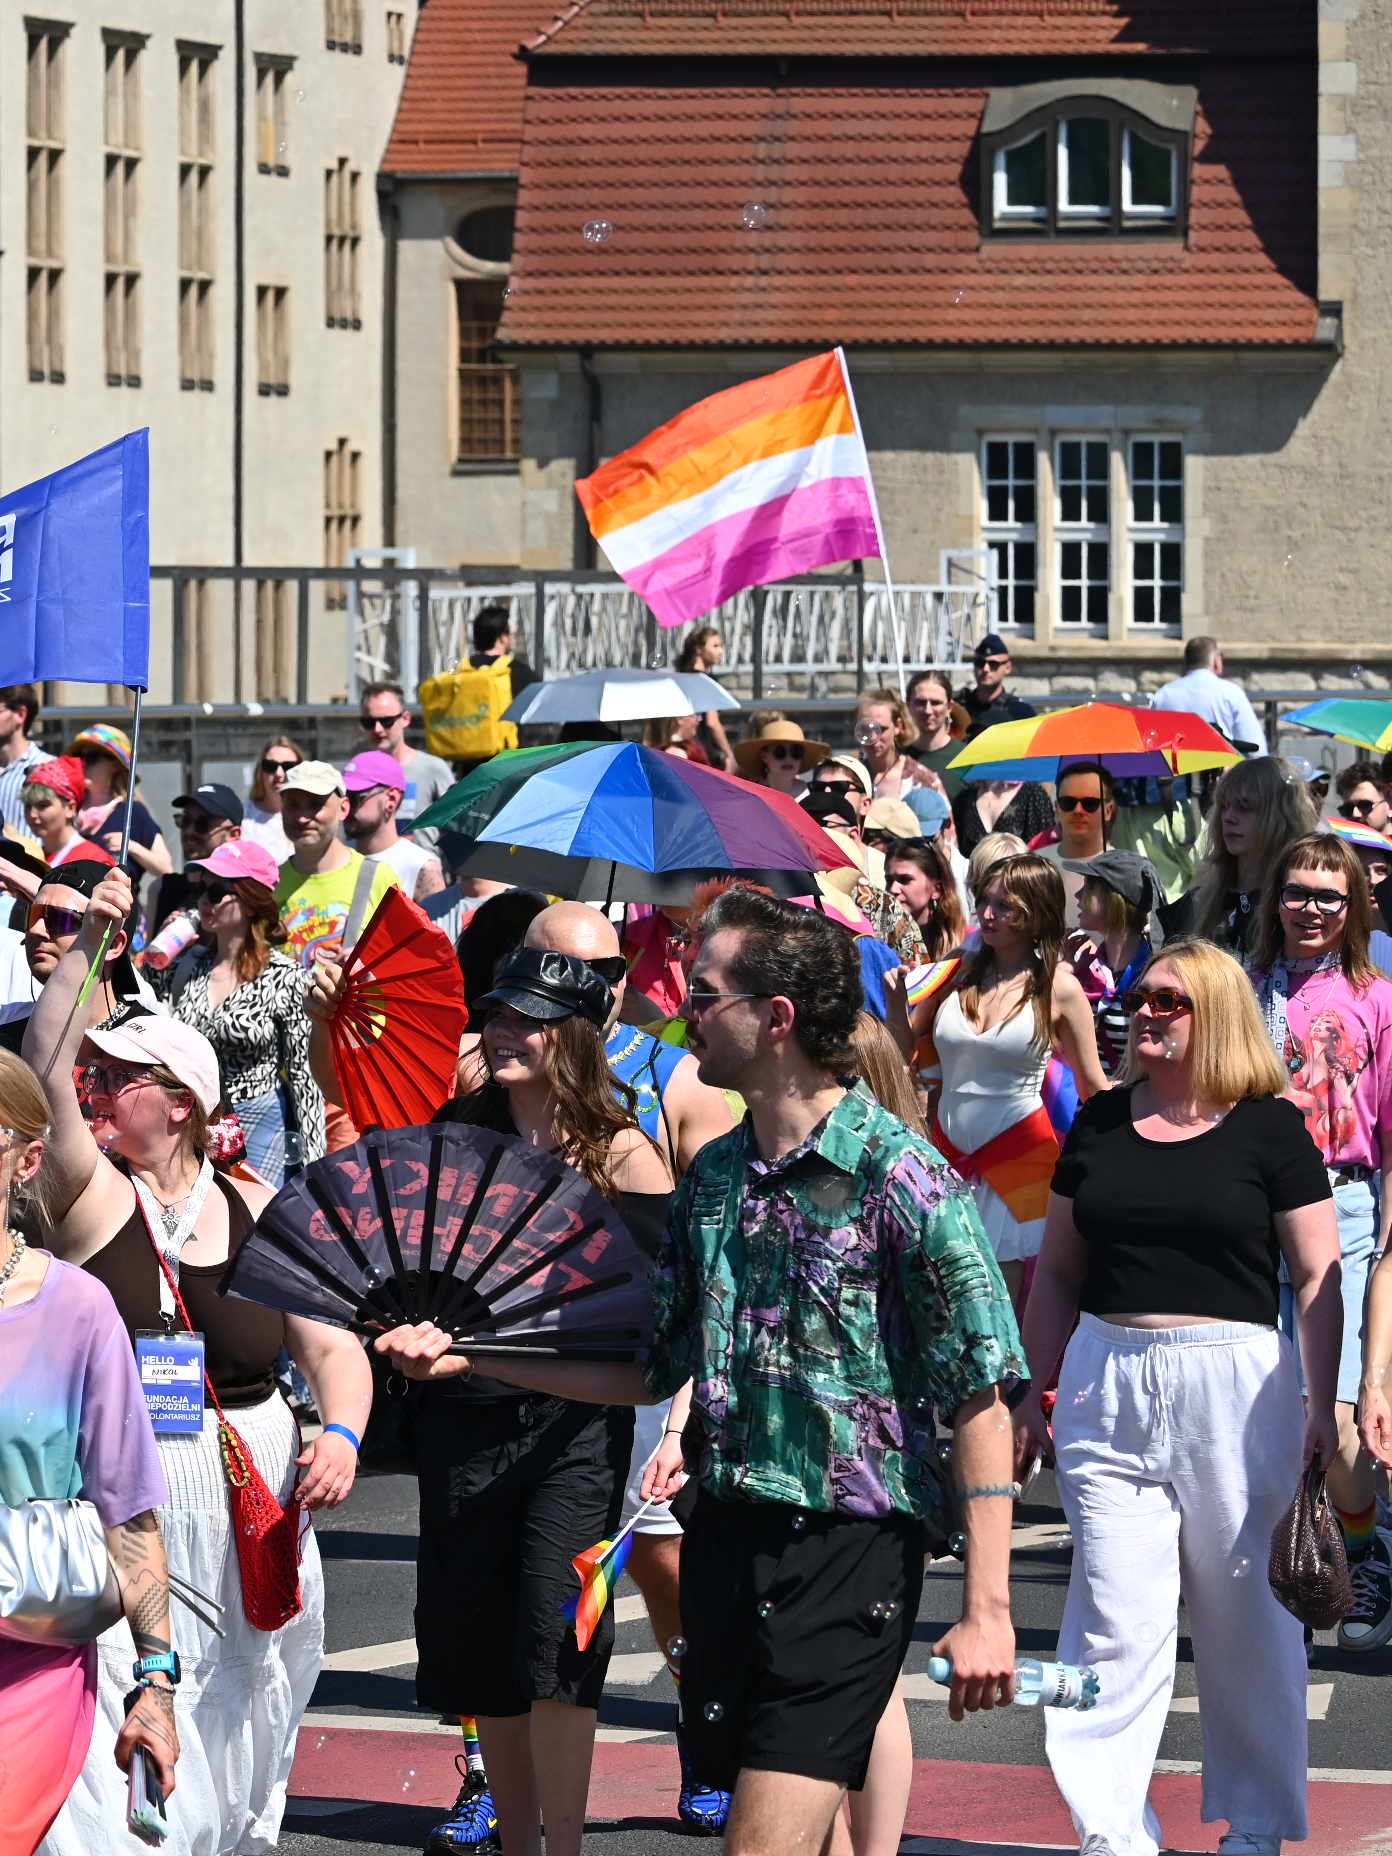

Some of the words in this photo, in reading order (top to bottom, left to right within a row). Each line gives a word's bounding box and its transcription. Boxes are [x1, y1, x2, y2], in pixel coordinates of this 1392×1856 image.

[141, 1355, 175, 1365] HELLO
[146, 1402, 201, 1412] IEPODZIELNI
[149, 1412, 201, 1421] OLONTARIUSZ
